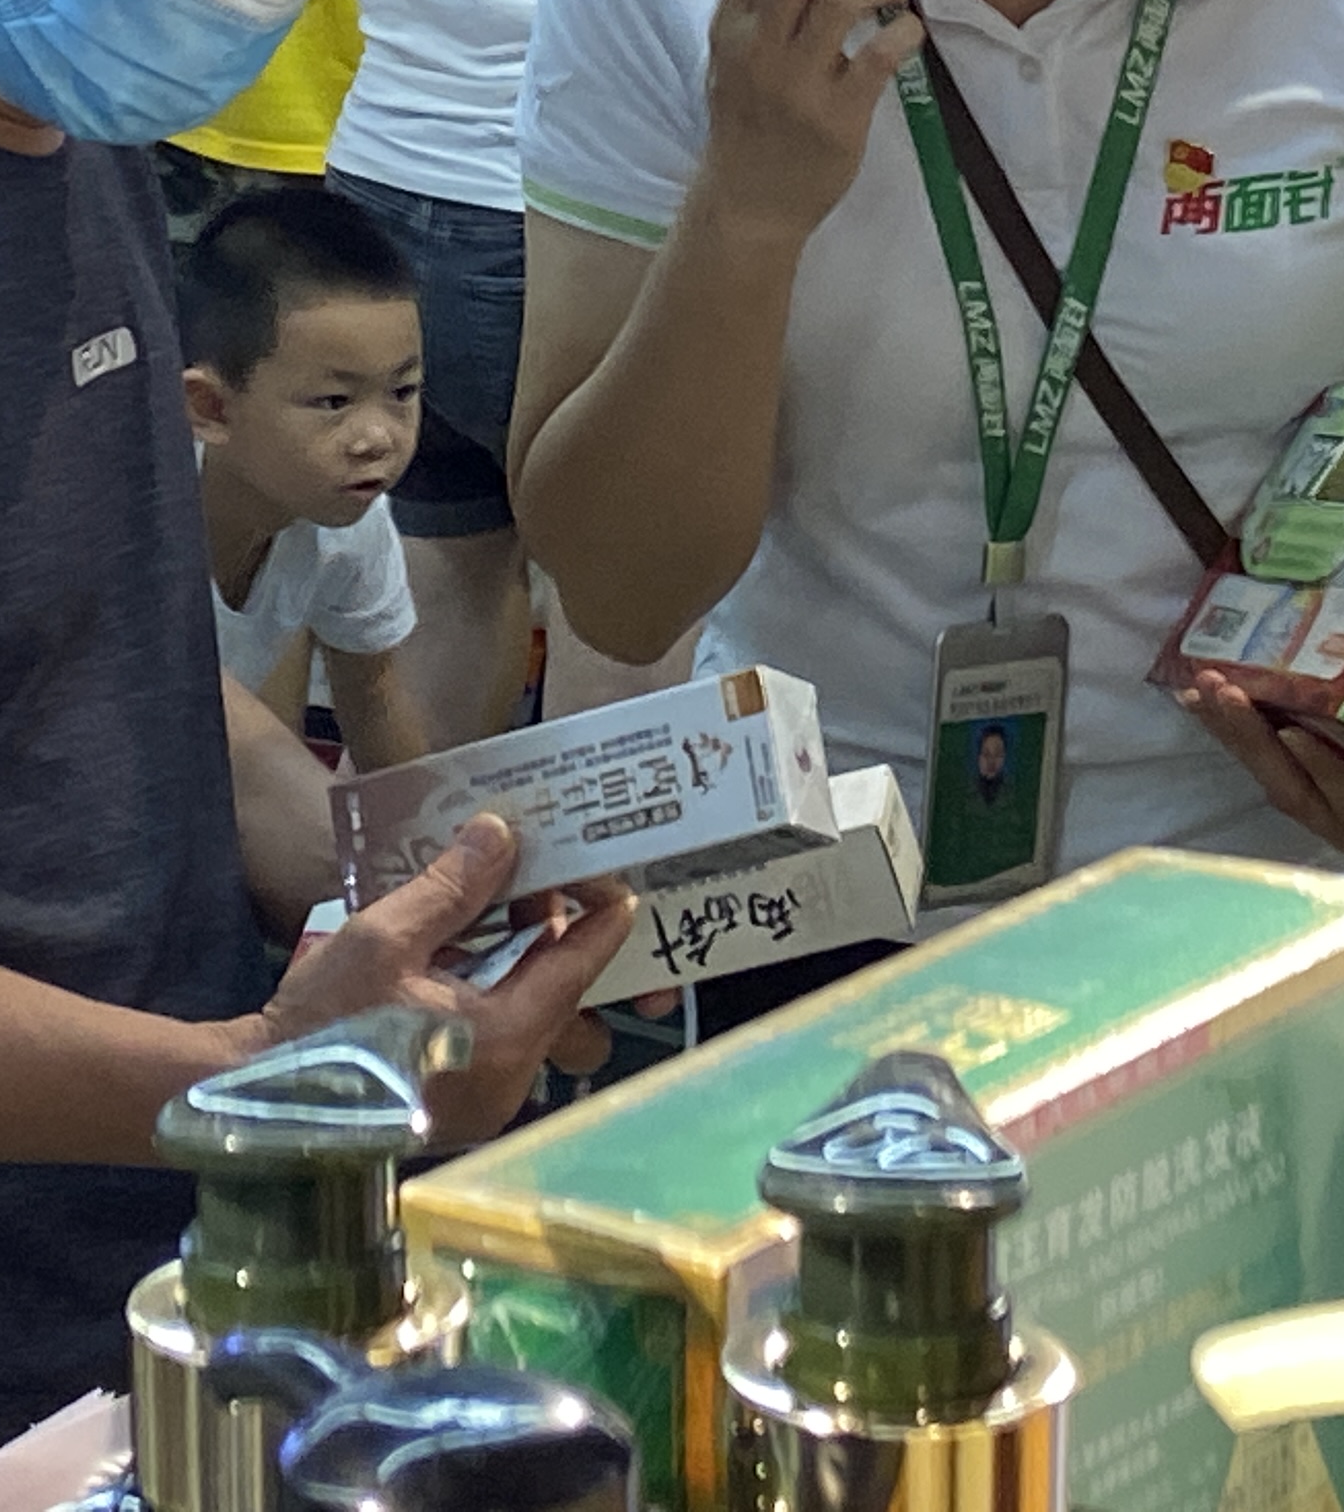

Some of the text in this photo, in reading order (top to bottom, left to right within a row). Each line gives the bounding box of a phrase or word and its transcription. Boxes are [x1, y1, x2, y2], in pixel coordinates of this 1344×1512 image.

[1113, 47, 1156, 126] LMZ
[1160, 164, 1334, 235] 两面针
[959, 281, 998, 356] LMZ
[1023, 383, 1067, 456] LMZ
